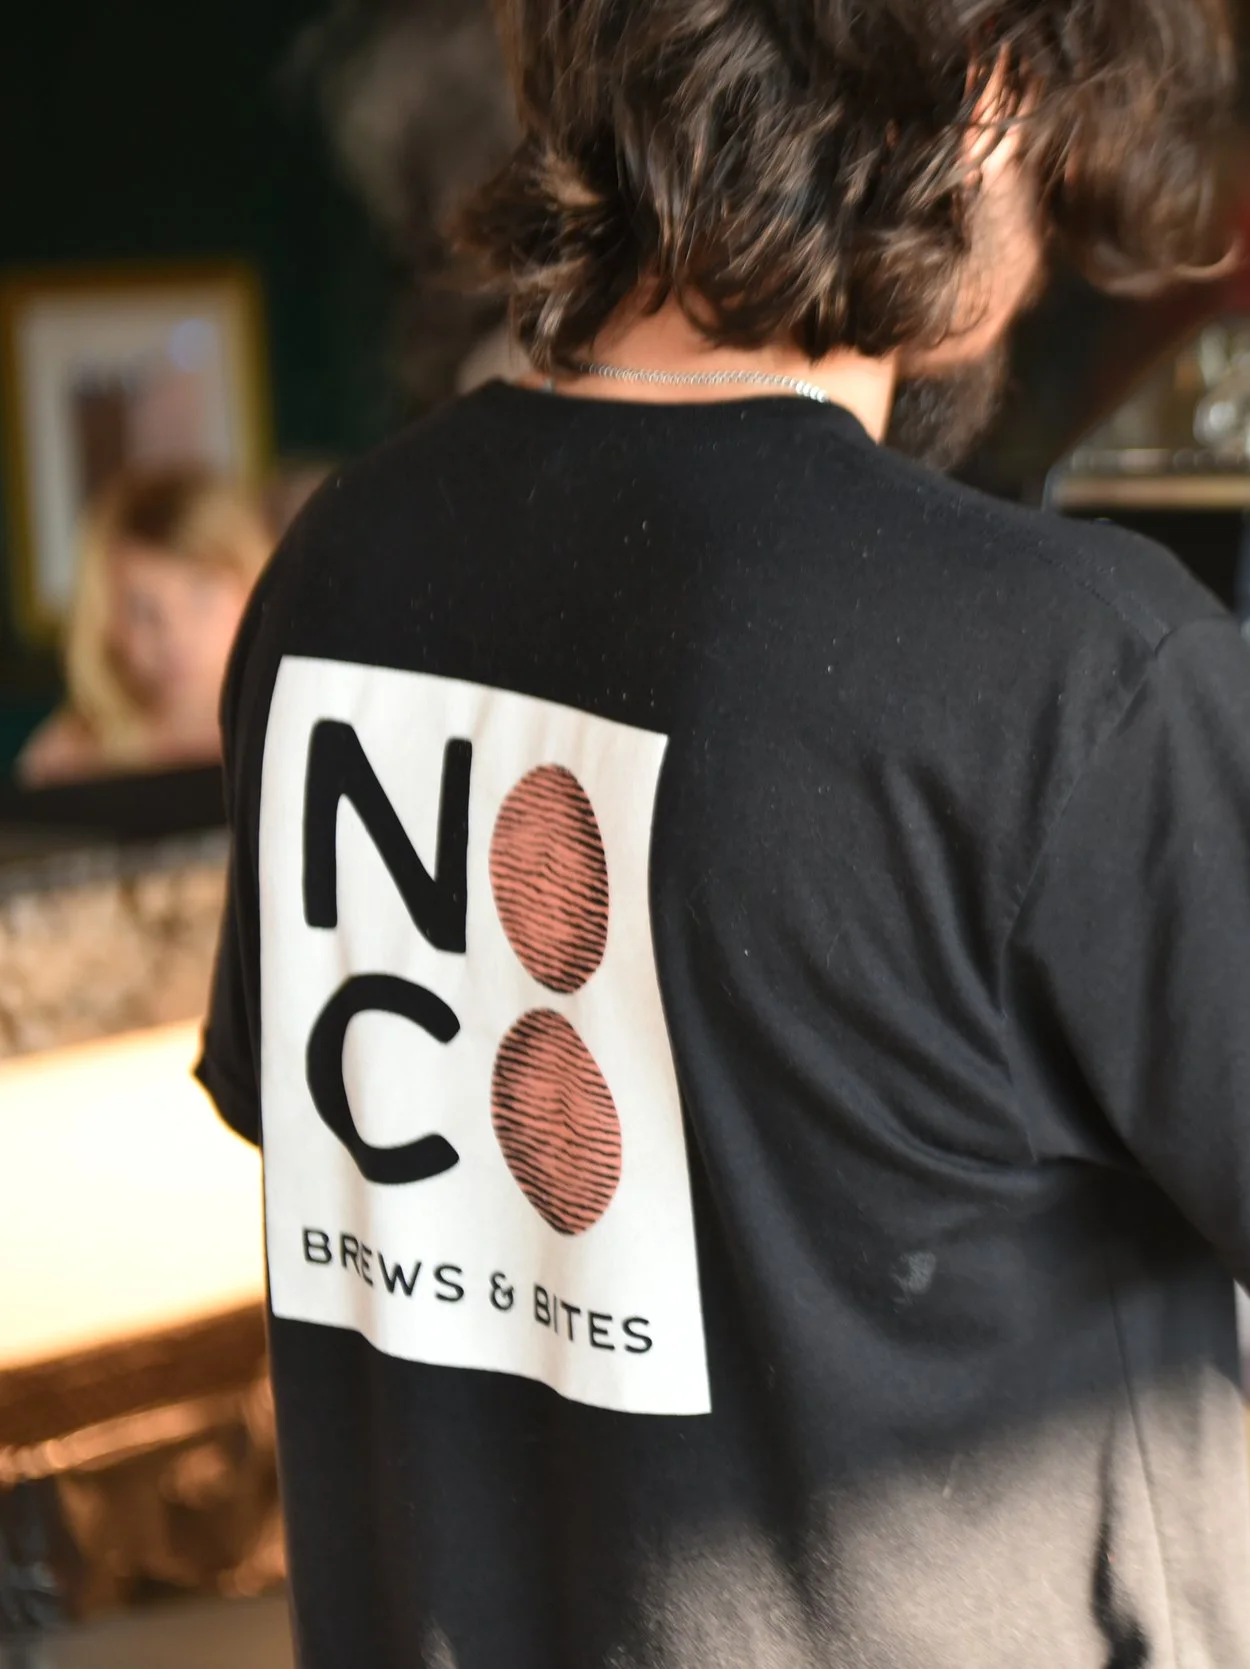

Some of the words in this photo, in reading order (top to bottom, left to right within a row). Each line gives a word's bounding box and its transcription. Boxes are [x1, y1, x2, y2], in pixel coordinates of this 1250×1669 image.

[303, 1228, 465, 1302] BREWS
[490, 1272, 514, 1311] &
[534, 1284, 653, 1354] BITES
